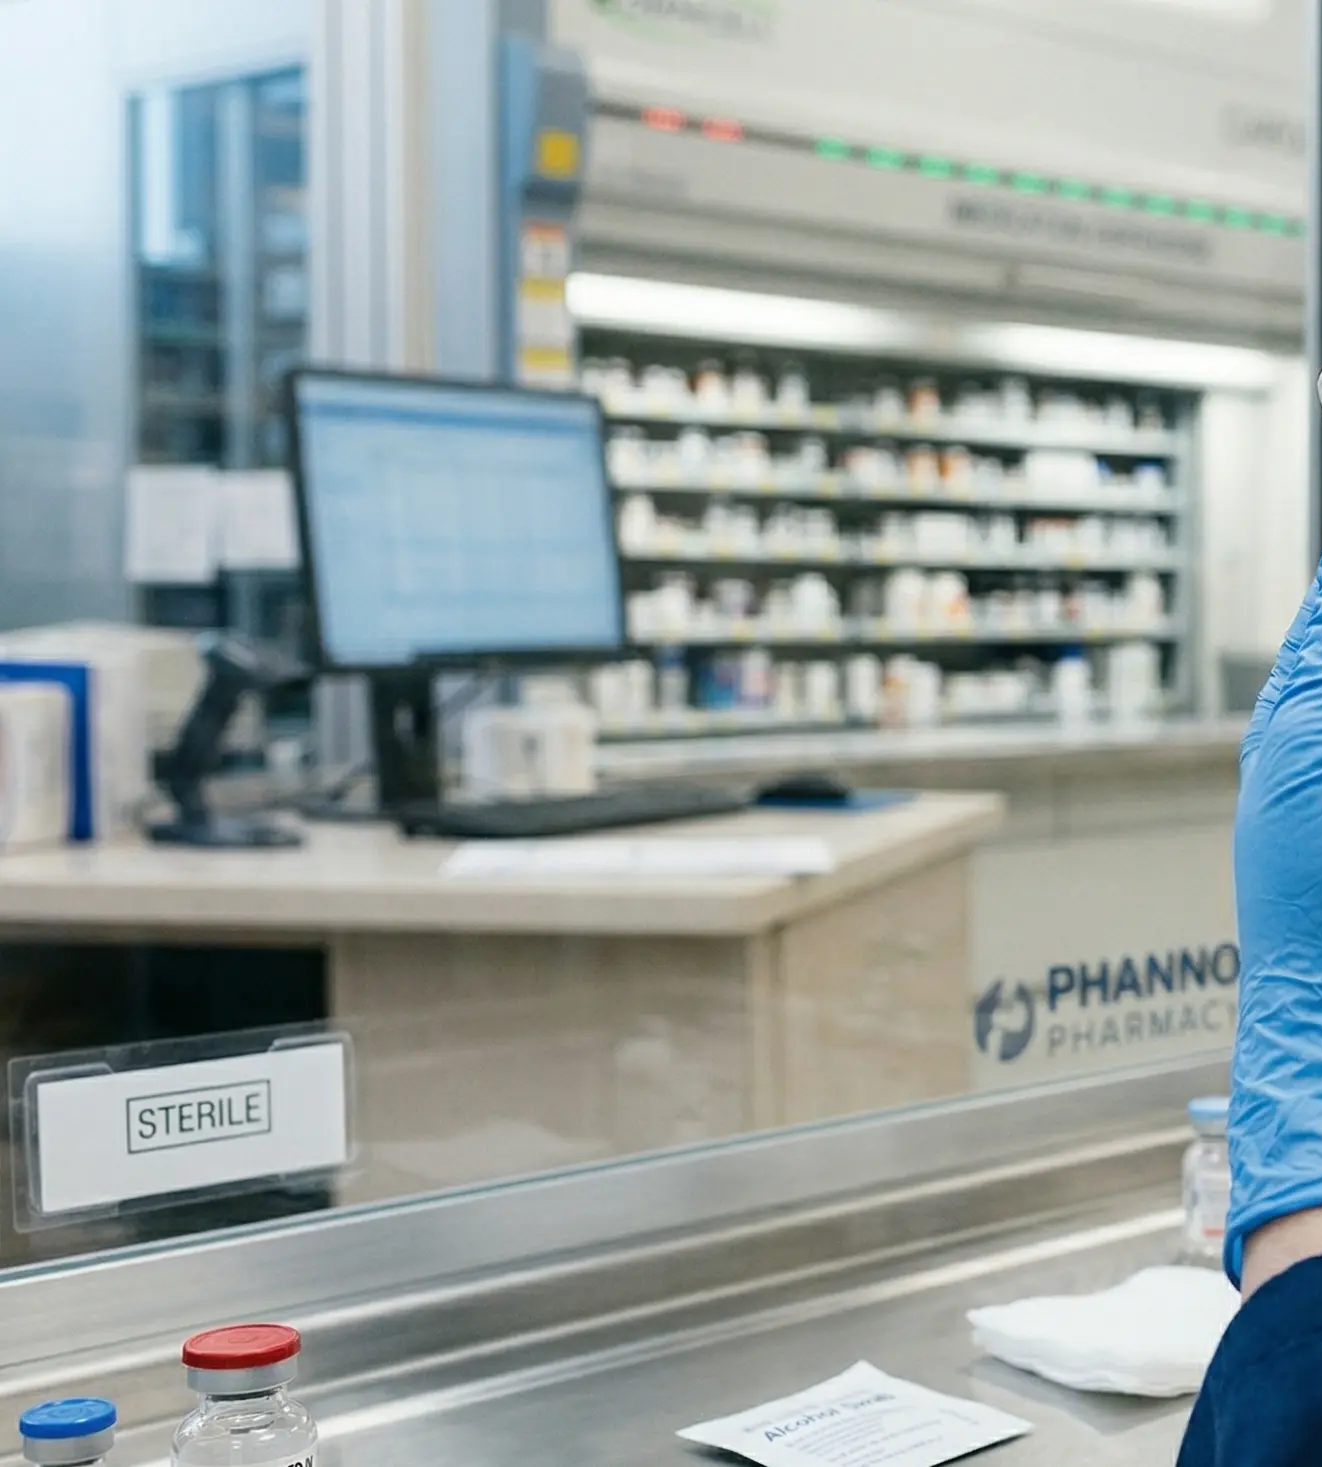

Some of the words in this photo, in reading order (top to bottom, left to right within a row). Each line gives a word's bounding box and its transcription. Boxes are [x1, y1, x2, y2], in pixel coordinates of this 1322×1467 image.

[1047, 943, 1241, 1012] PHANNO
[138, 1093, 262, 1139] STERILE
[763, 1407, 841, 1442] Alcohol
